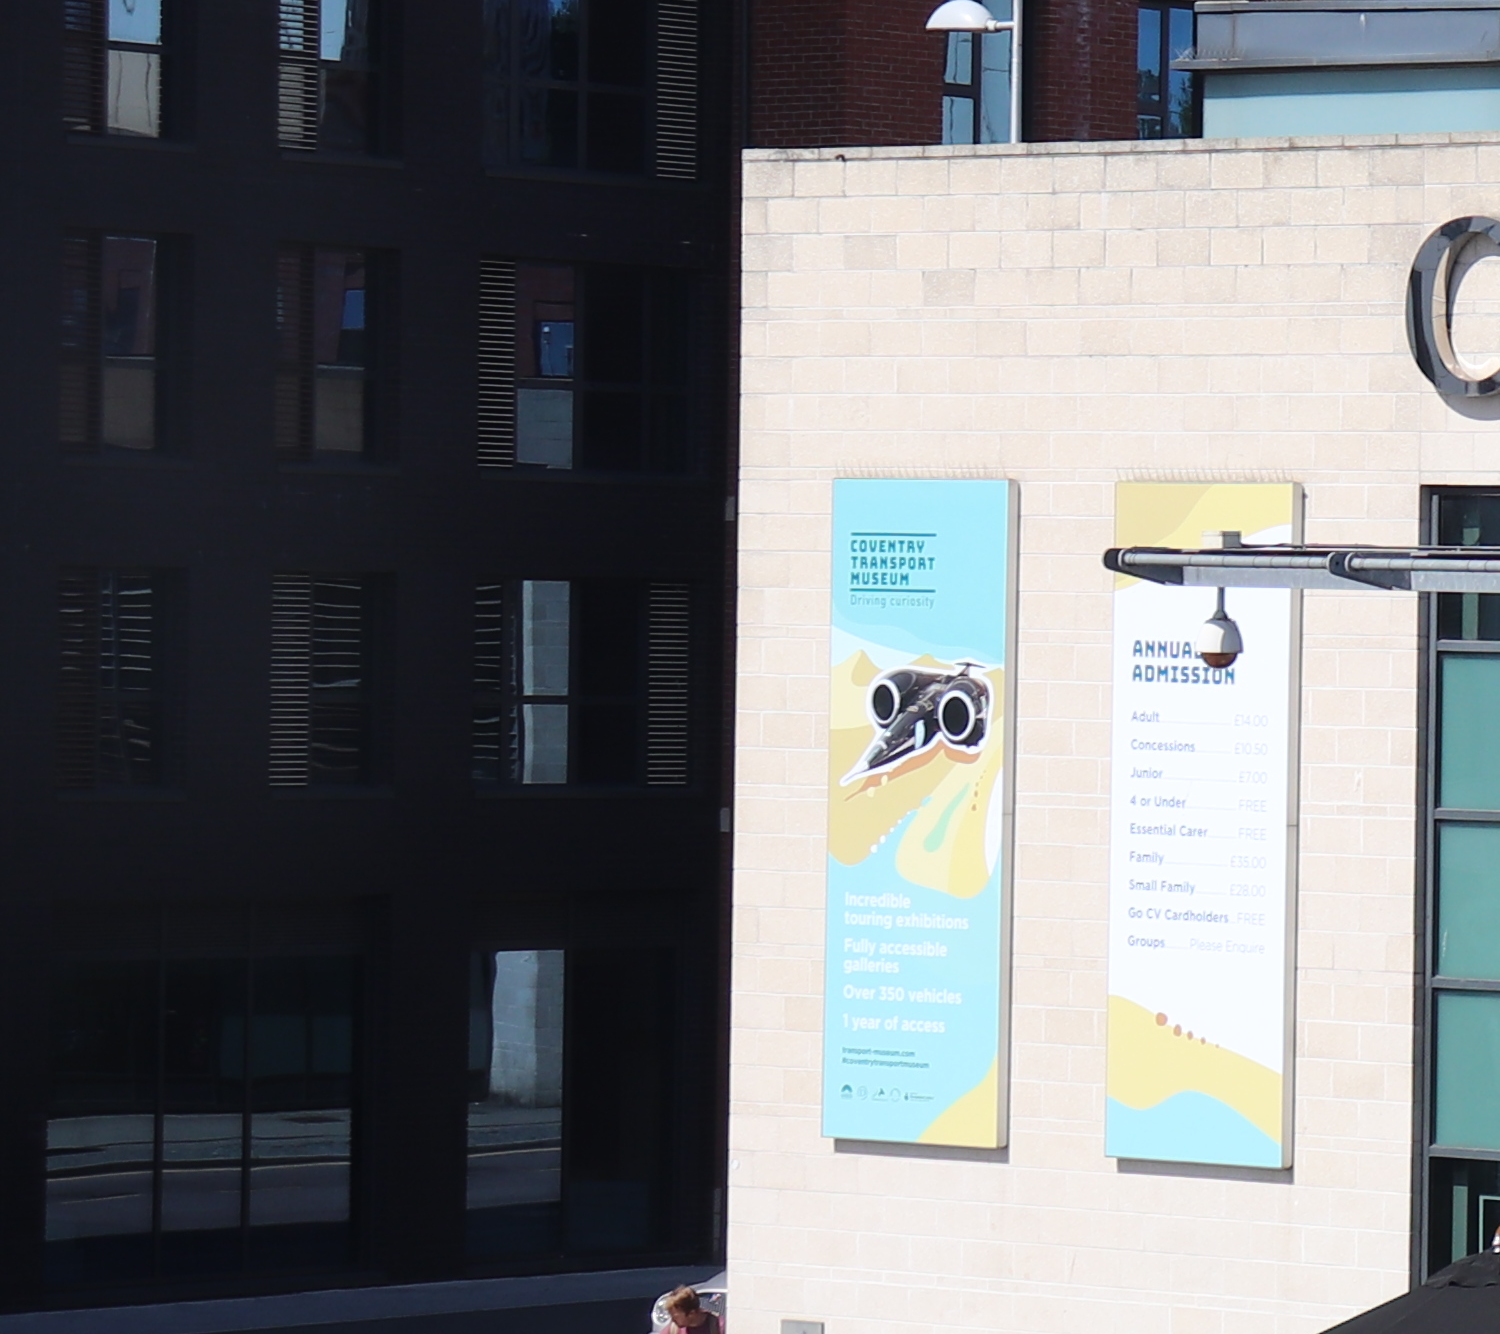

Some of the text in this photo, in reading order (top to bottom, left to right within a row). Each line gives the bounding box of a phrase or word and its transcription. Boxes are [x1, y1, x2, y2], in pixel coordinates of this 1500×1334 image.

[851, 540, 925, 553] COVENTRY
[851, 556, 935, 570] TRANSPORT
[850, 572, 909, 586] MUSEUM
[850, 594, 935, 609] Driving curiosity
[1132, 664, 1235, 685] ADMISSION
[1131, 710, 1268, 727] Adult £14.00
[1130, 739, 1268, 756] Concessions £10.50
[1130, 767, 1268, 784] Junior £7.00
[1130, 795, 1267, 812] 4 or Under FREE
[1130, 823, 1267, 841] Essential Carer FREE
[1129, 851, 1164, 866] Family
[1129, 879, 1157, 891] Small
[1161, 880, 1196, 895] Family
[845, 891, 911, 909] Incredible
[844, 911, 969, 930] touring exhibitions
[1128, 907, 1265, 926] Go CV Cardholders FREE
[844, 938, 948, 957] Fully accessible
[1128, 935, 1265, 955] Groups Please Enquire
[844, 957, 900, 974] galleries
[843, 984, 962, 1004] Over 350 vehicles
[843, 1013, 945, 1033] 1 year of access
